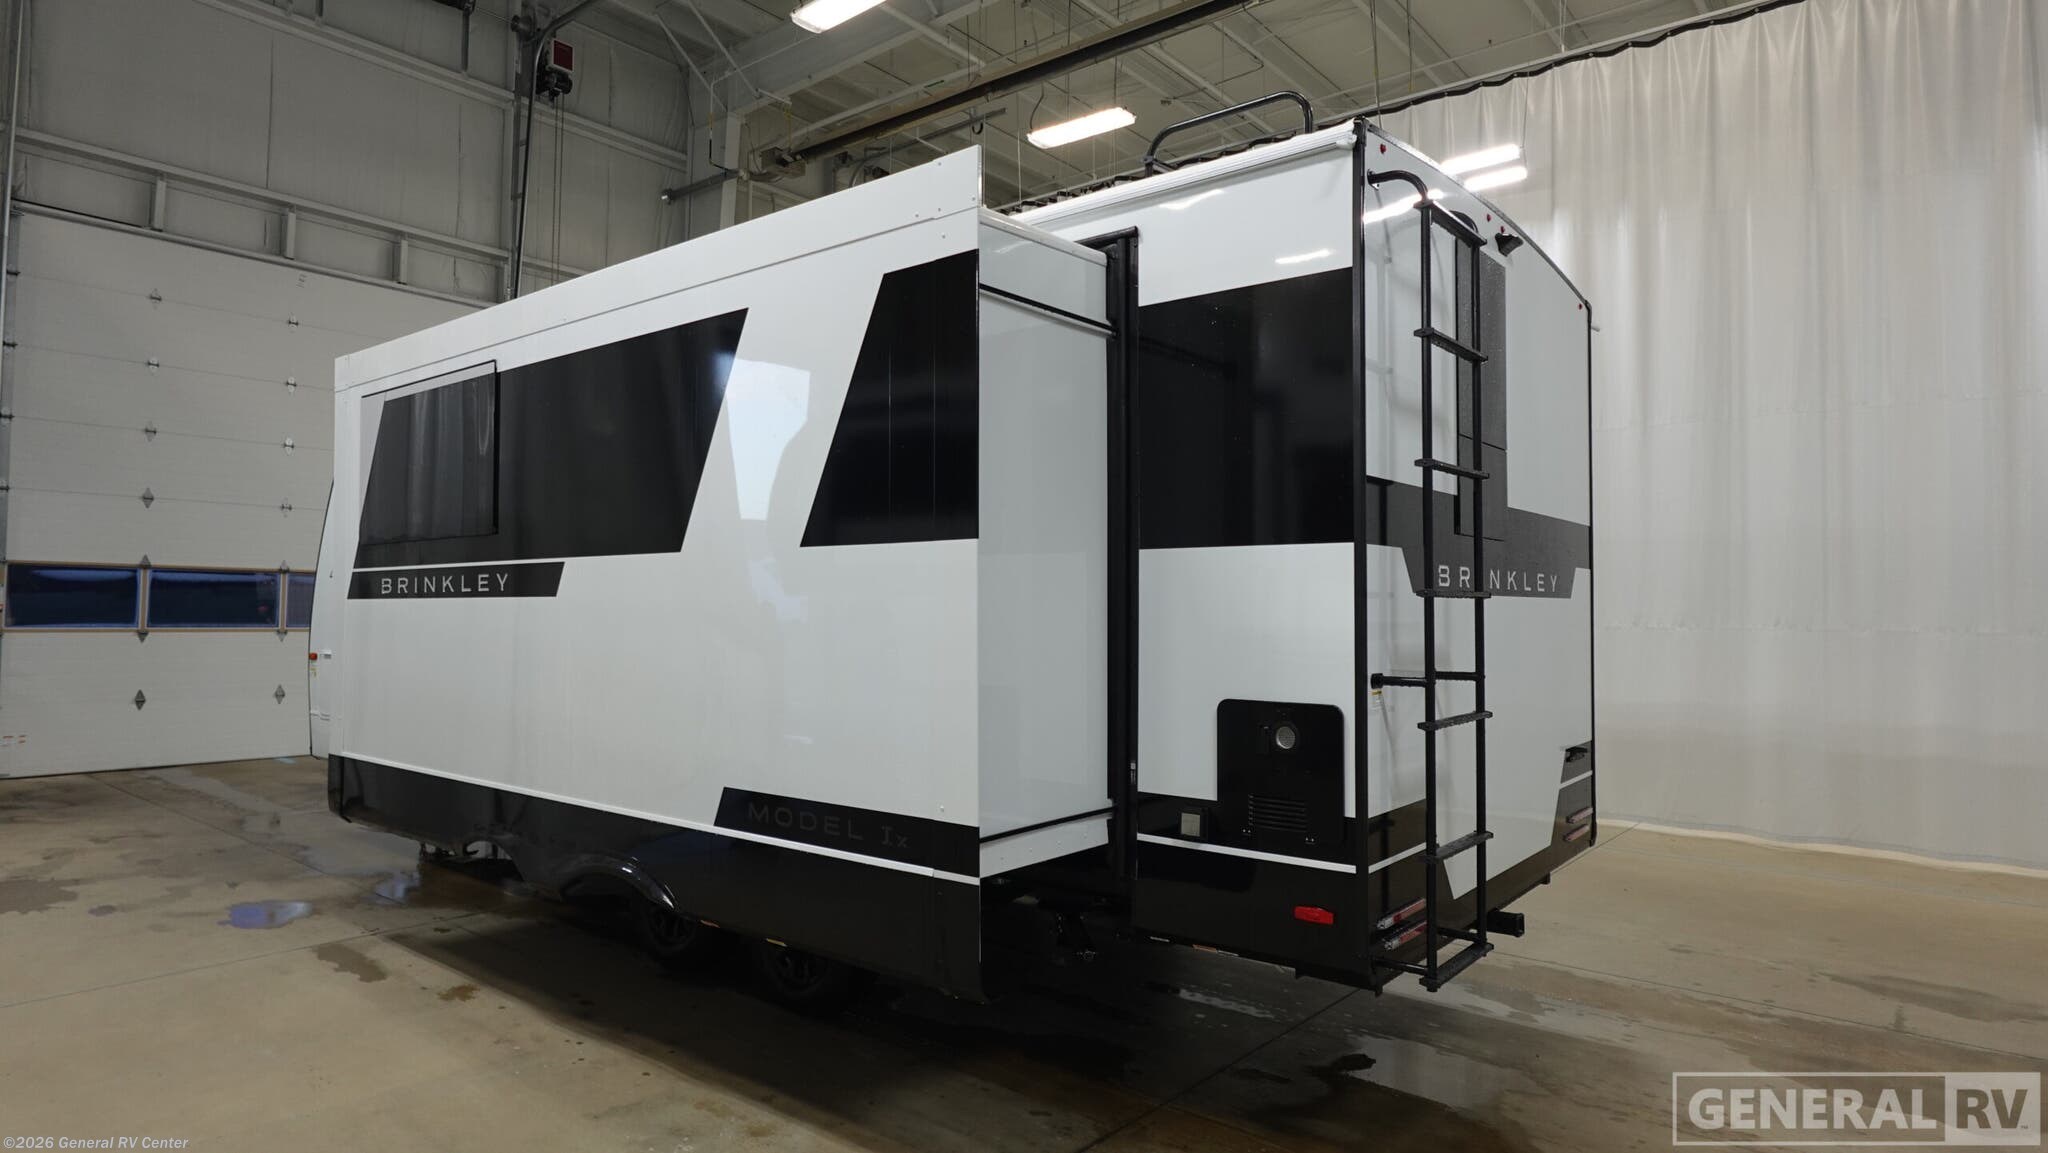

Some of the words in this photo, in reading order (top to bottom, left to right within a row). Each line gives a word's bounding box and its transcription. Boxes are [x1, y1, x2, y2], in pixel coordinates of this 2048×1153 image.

[381, 573, 508, 594] BRINKLEY
[1438, 565, 1557, 592] BRNKLEY
[748, 802, 864, 841] MODEL
